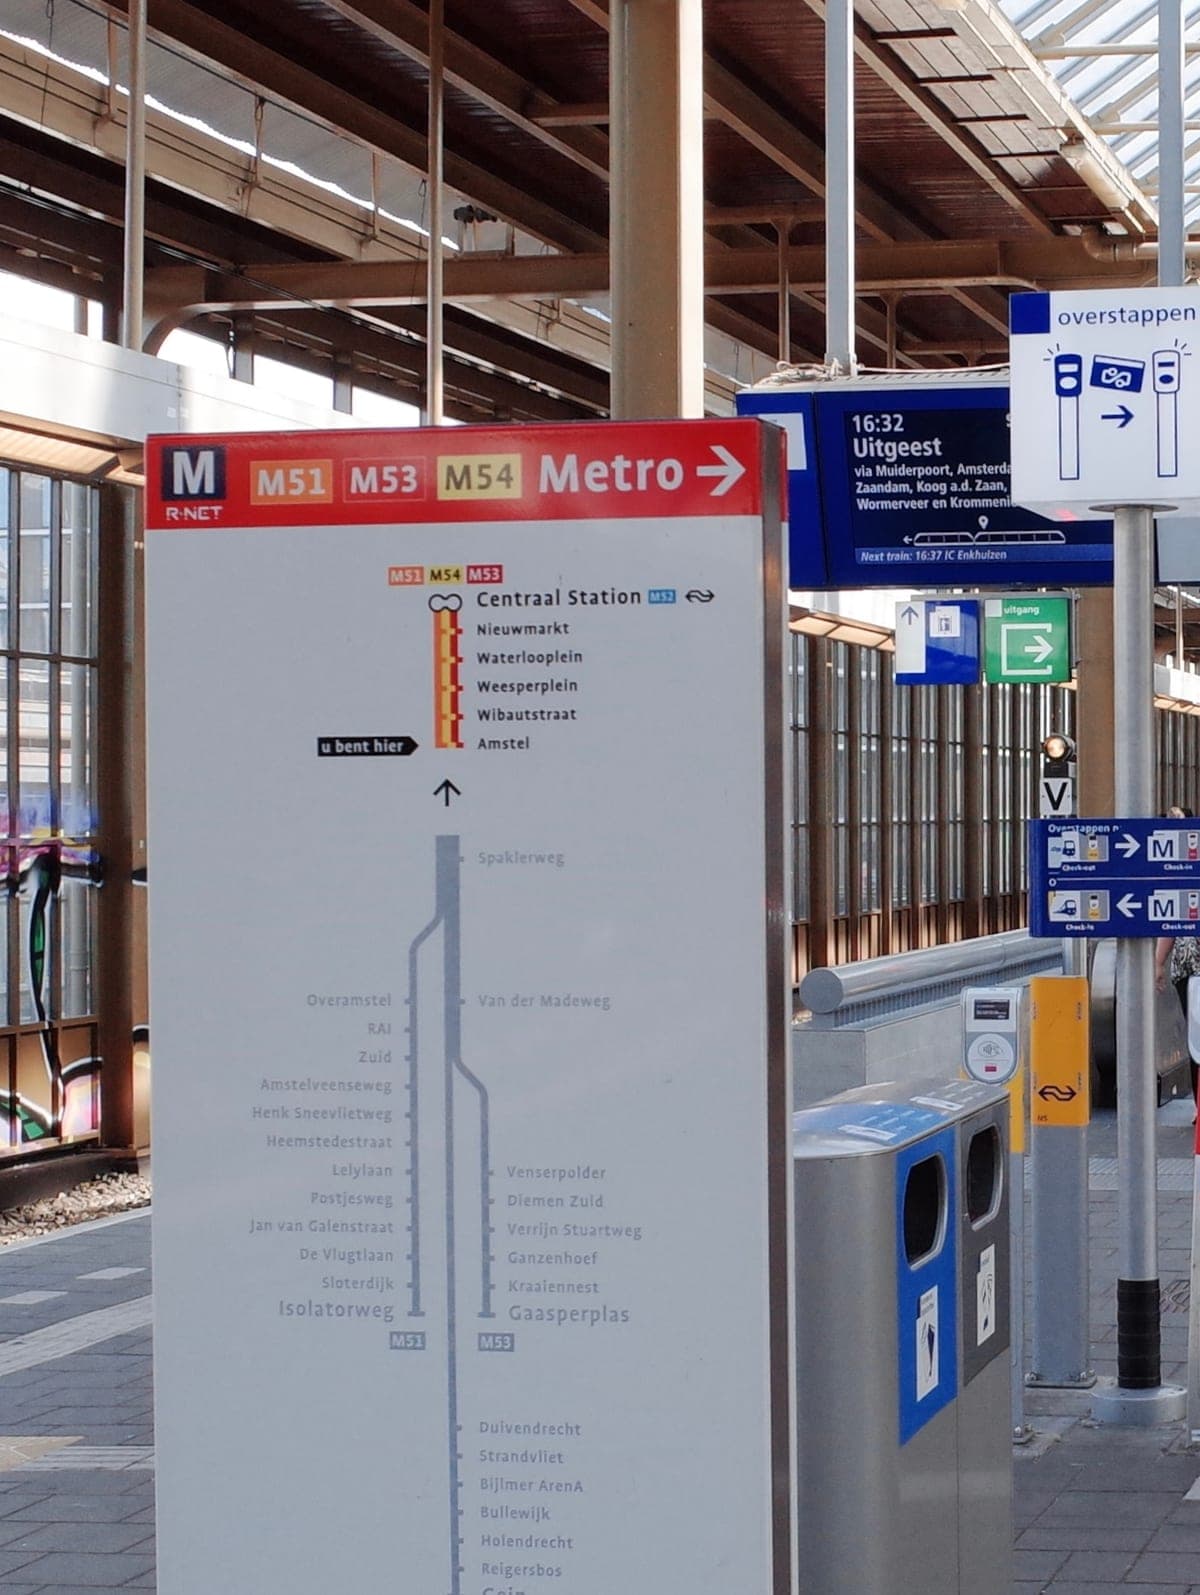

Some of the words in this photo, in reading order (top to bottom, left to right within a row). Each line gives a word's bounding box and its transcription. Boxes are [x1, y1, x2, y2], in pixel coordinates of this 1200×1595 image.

[1059, 308, 1195, 327] overstappen
[853, 414, 904, 432] 16:32
[854, 437, 942, 462] Uitgeest
[171, 451, 214, 496] M
[257, 469, 326, 495] M51
[350, 465, 418, 494] M53
[445, 460, 513, 491] M54
[539, 454, 684, 493] Metro
[855, 465, 872, 477] via
[876, 462, 953, 478] Muiderpoort,
[856, 481, 913, 496] Zaandam,
[917, 480, 947, 495] Koog
[950, 480, 972, 491] a.d.
[975, 480, 1007, 494] Zaan,
[857, 498, 928, 510] Wormerveer
[931, 499, 947, 509] en
[861, 552, 884, 561] Next
[887, 551, 912, 561] train:
[916, 551, 942, 560] 16:37
[945, 550, 955, 560] IC
[957, 549, 1006, 560] Enkhuizen
[390, 569, 422, 582] M51
[431, 569, 460, 581] M54
[468, 568, 500, 581] M53
[477, 589, 559, 607] Centraal
[569, 588, 640, 605] Station
[650, 592, 674, 602] M52
[1004, 605, 1039, 617] uitgang
[478, 622, 568, 635] Nieuwmarkt
[477, 650, 582, 666] Waterlooplein
[477, 679, 577, 695] Weesperplein
[478, 708, 576, 721] Wibautstraat
[322, 743, 330, 753] u
[335, 739, 369, 755] bent
[375, 738, 404, 755] hier
[478, 737, 529, 749] Amstel
[1044, 782, 1067, 810] V
[1153, 840, 1173, 857] M
[479, 851, 564, 867] Spaklerweg
[1154, 900, 1173, 917] M
[307, 993, 391, 1008] Overamstel
[478, 995, 505, 1008] Van
[511, 994, 534, 1007] der
[541, 994, 610, 1011] Madeweg
[368, 1023, 391, 1034] RAI
[359, 1051, 391, 1064] Zuid
[261, 1078, 392, 1096] Amstelveenseweg
[252, 1107, 289, 1120] Henk
[294, 1107, 392, 1123] Sneevlietweg
[267, 1135, 392, 1148] Heemstedestraat
[333, 1163, 392, 1179] Lelylaan
[507, 1166, 605, 1182] Venserpolder
[311, 1192, 392, 1208] Postjesweg
[508, 1194, 563, 1208] Diemen
[568, 1195, 603, 1207] Zuid
[249, 1219, 272, 1233] Jan
[278, 1222, 302, 1231] van
[309, 1219, 393, 1233] Galenstraat
[508, 1222, 557, 1239] Verrijn
[563, 1224, 642, 1240] Stuartweg
[300, 1248, 317, 1260] De
[323, 1248, 393, 1264] Vlugtlaan
[508, 1252, 597, 1264] Ganzenhoef
[320, 1276, 394, 1293] Sloterdijk
[509, 1280, 598, 1293] Kraaiennest
[280, 1300, 394, 1323] Isolatorweg
[509, 1305, 629, 1326] Gaasperplas
[393, 1335, 424, 1348] M51
[480, 1337, 512, 1349] M53
[480, 1421, 580, 1436] Duivendrecht
[480, 1448, 563, 1464] Strandvliet
[481, 1477, 533, 1493] Bijlmer
[539, 1480, 583, 1492] ArenA
[481, 1504, 550, 1520] Bullewijk
[482, 1534, 573, 1549] Holendrecht
[482, 1562, 562, 1578] Reigersbos
